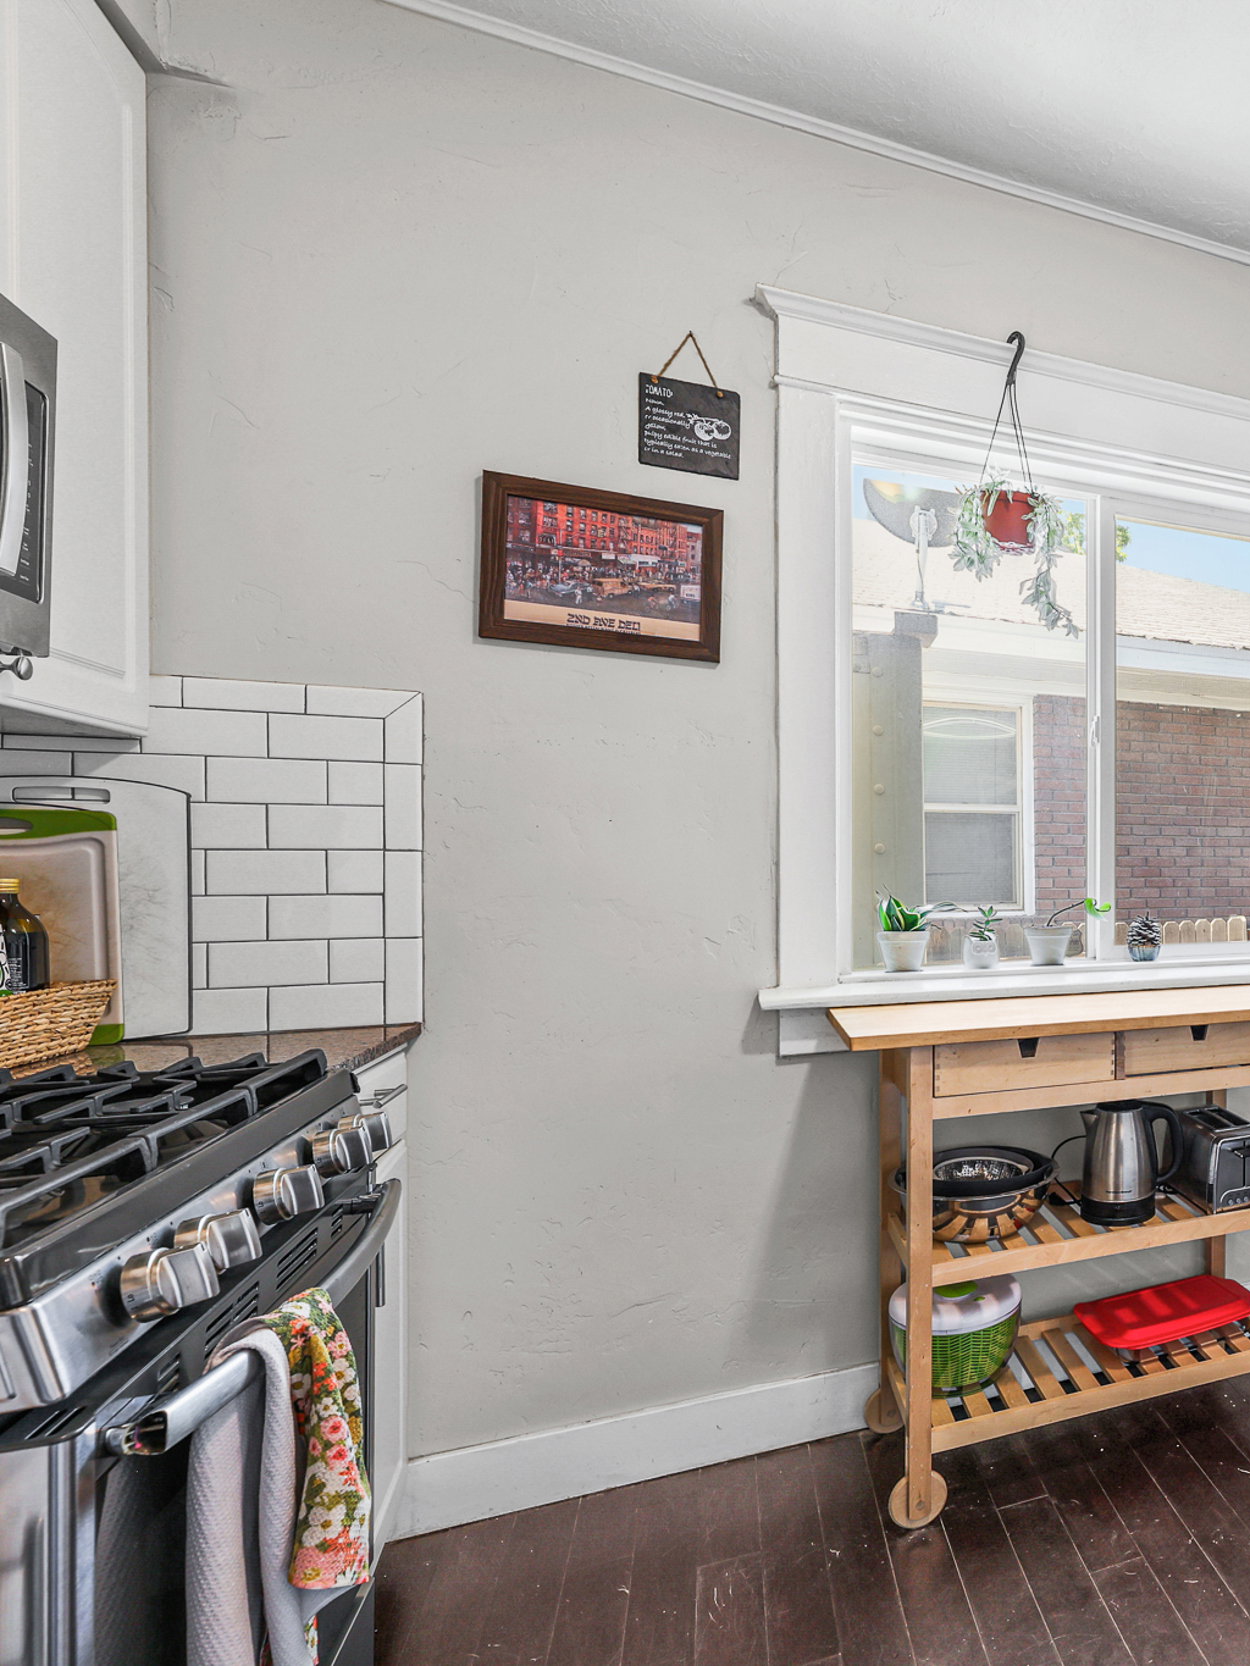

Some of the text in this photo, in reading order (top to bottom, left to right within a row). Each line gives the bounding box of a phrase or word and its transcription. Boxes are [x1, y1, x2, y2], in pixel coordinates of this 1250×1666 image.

[652, 415, 690, 429] occasionally
[567, 613, 591, 625] 2ND
[593, 616, 616, 628] AVE
[618, 619, 641, 631] DELI
